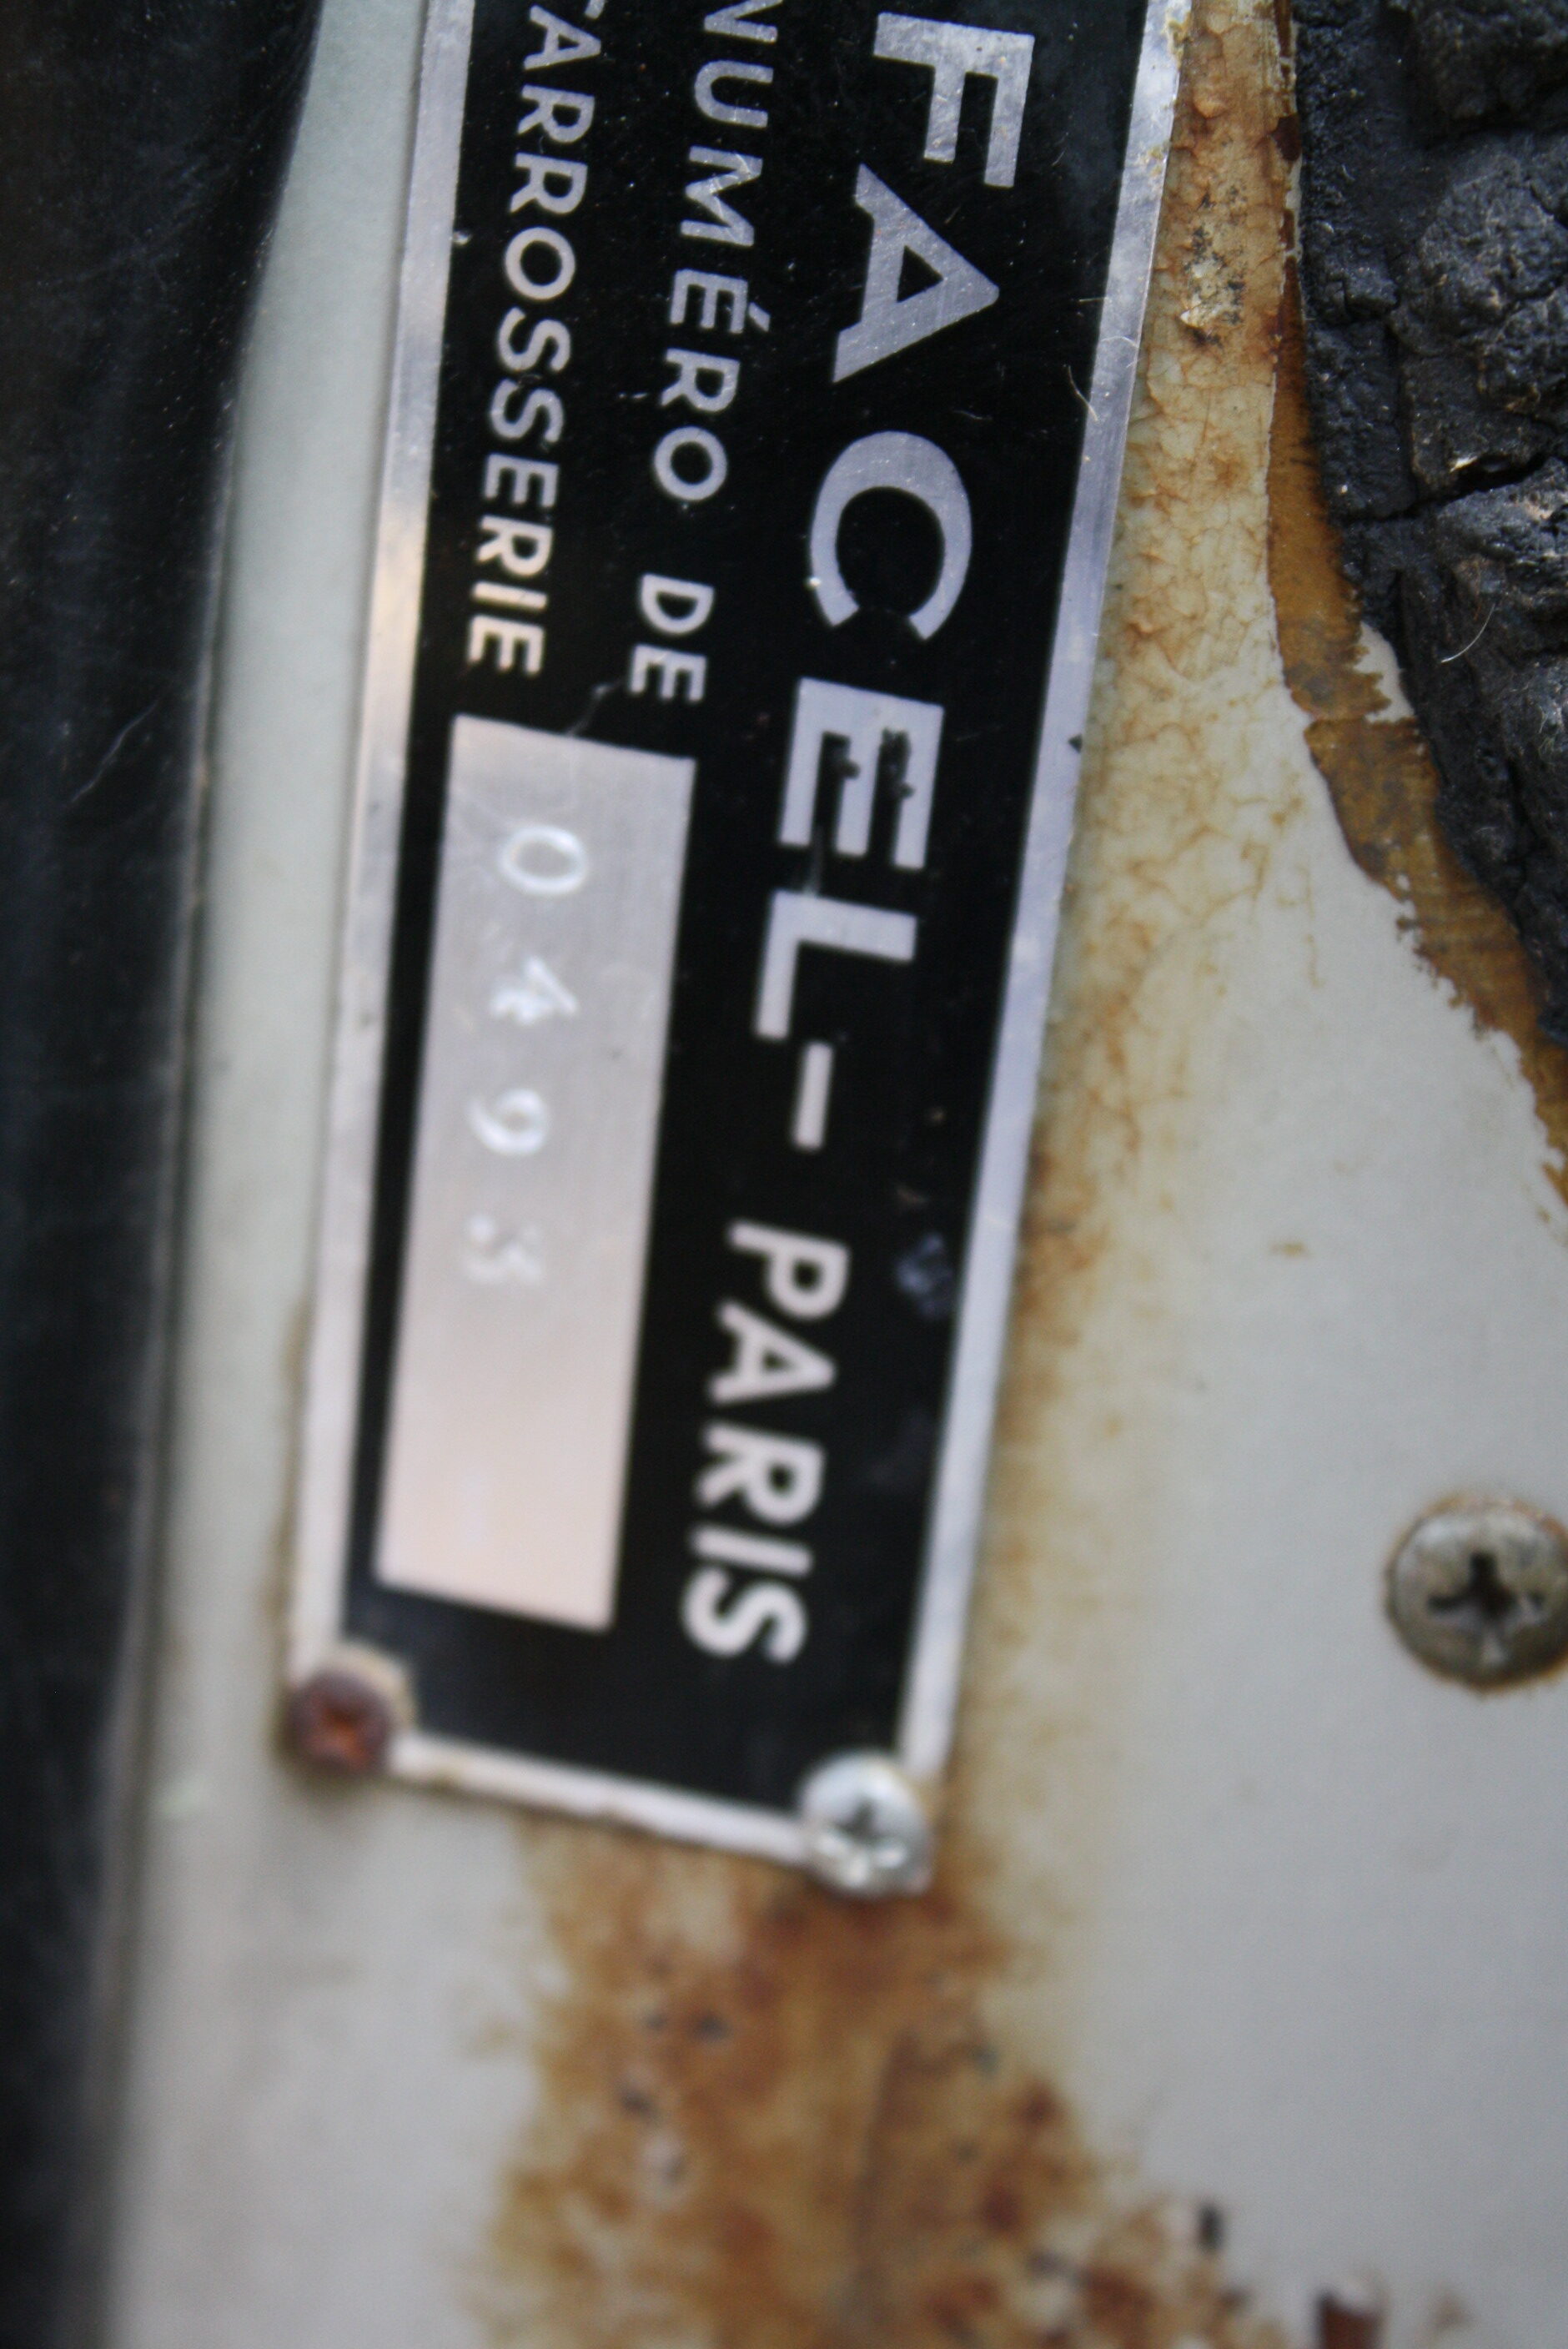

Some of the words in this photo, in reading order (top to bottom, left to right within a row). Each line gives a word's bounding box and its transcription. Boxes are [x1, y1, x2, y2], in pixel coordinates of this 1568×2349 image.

[465, 0, 605, 676] ARROSSERIE
[628, 573, 715, 702] DE
[465, 824, 587, 1288] 0493
[681, 1219, 851, 1663] PARIS
